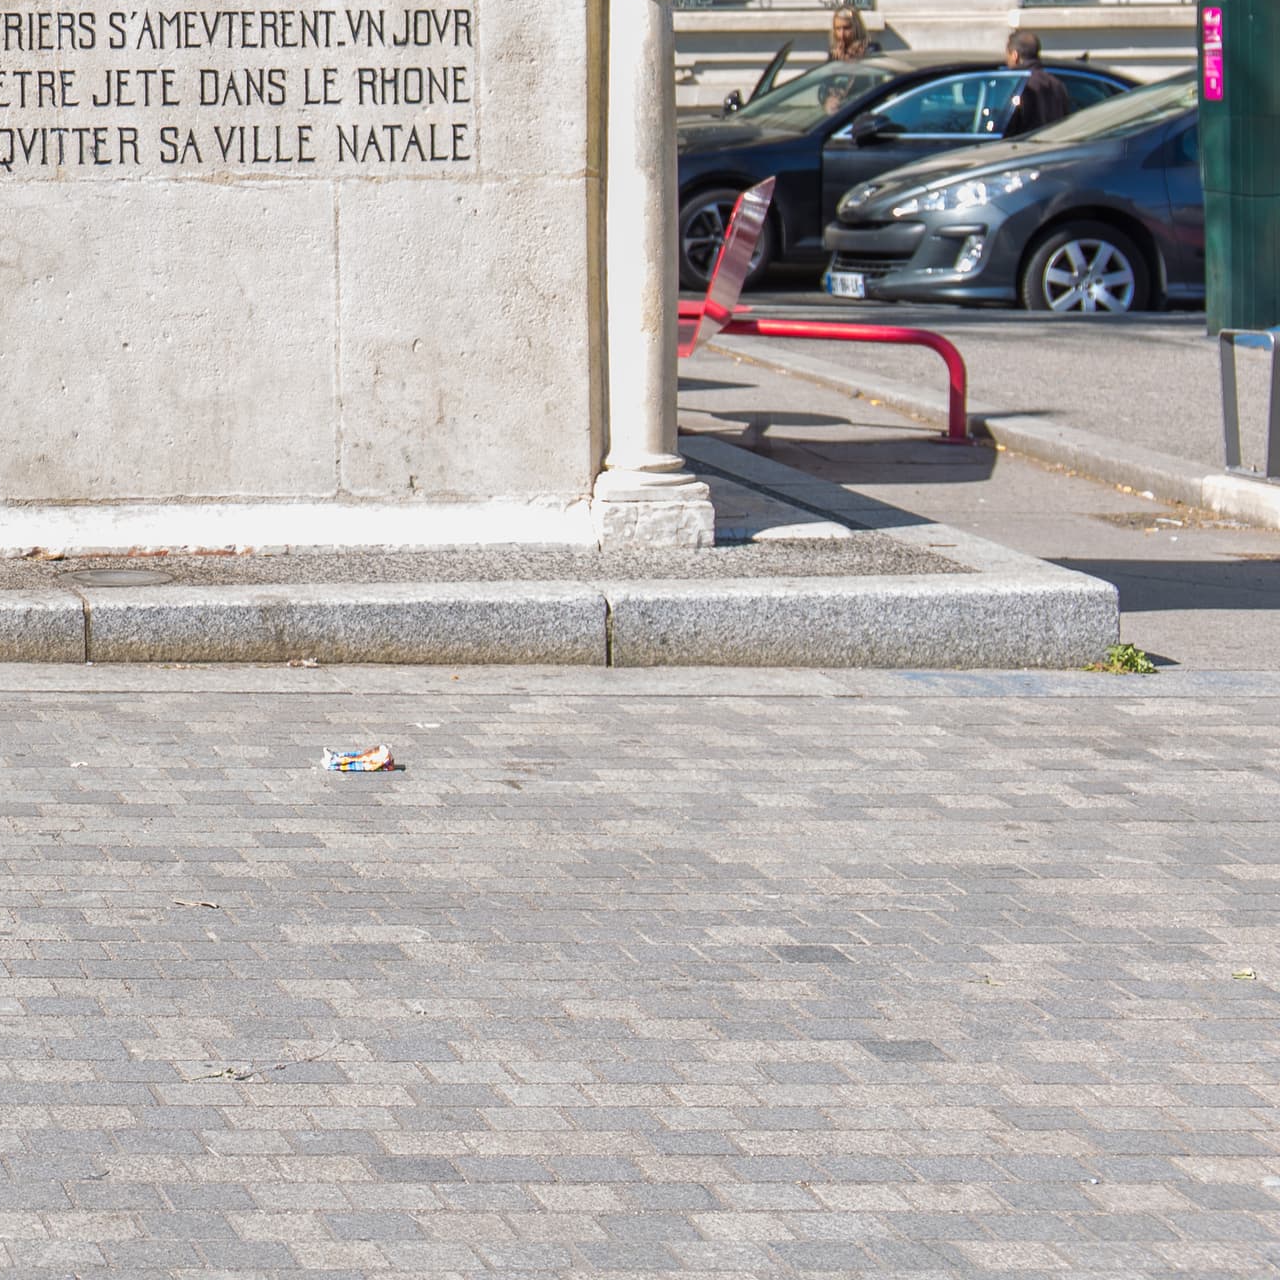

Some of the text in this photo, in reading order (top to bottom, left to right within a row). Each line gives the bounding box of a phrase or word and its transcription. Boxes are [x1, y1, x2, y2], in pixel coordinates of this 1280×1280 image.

[345, 9, 385, 47] VN
[392, 9, 473, 47] JOVR
[92, 69, 180, 107] JETE
[199, 68, 286, 107] DANS
[303, 68, 342, 106] LE
[357, 66, 471, 105] RHONE
[159, 126, 203, 165] SA
[213, 125, 316, 164] VILLE
[336, 123, 471, 163] NATALE
